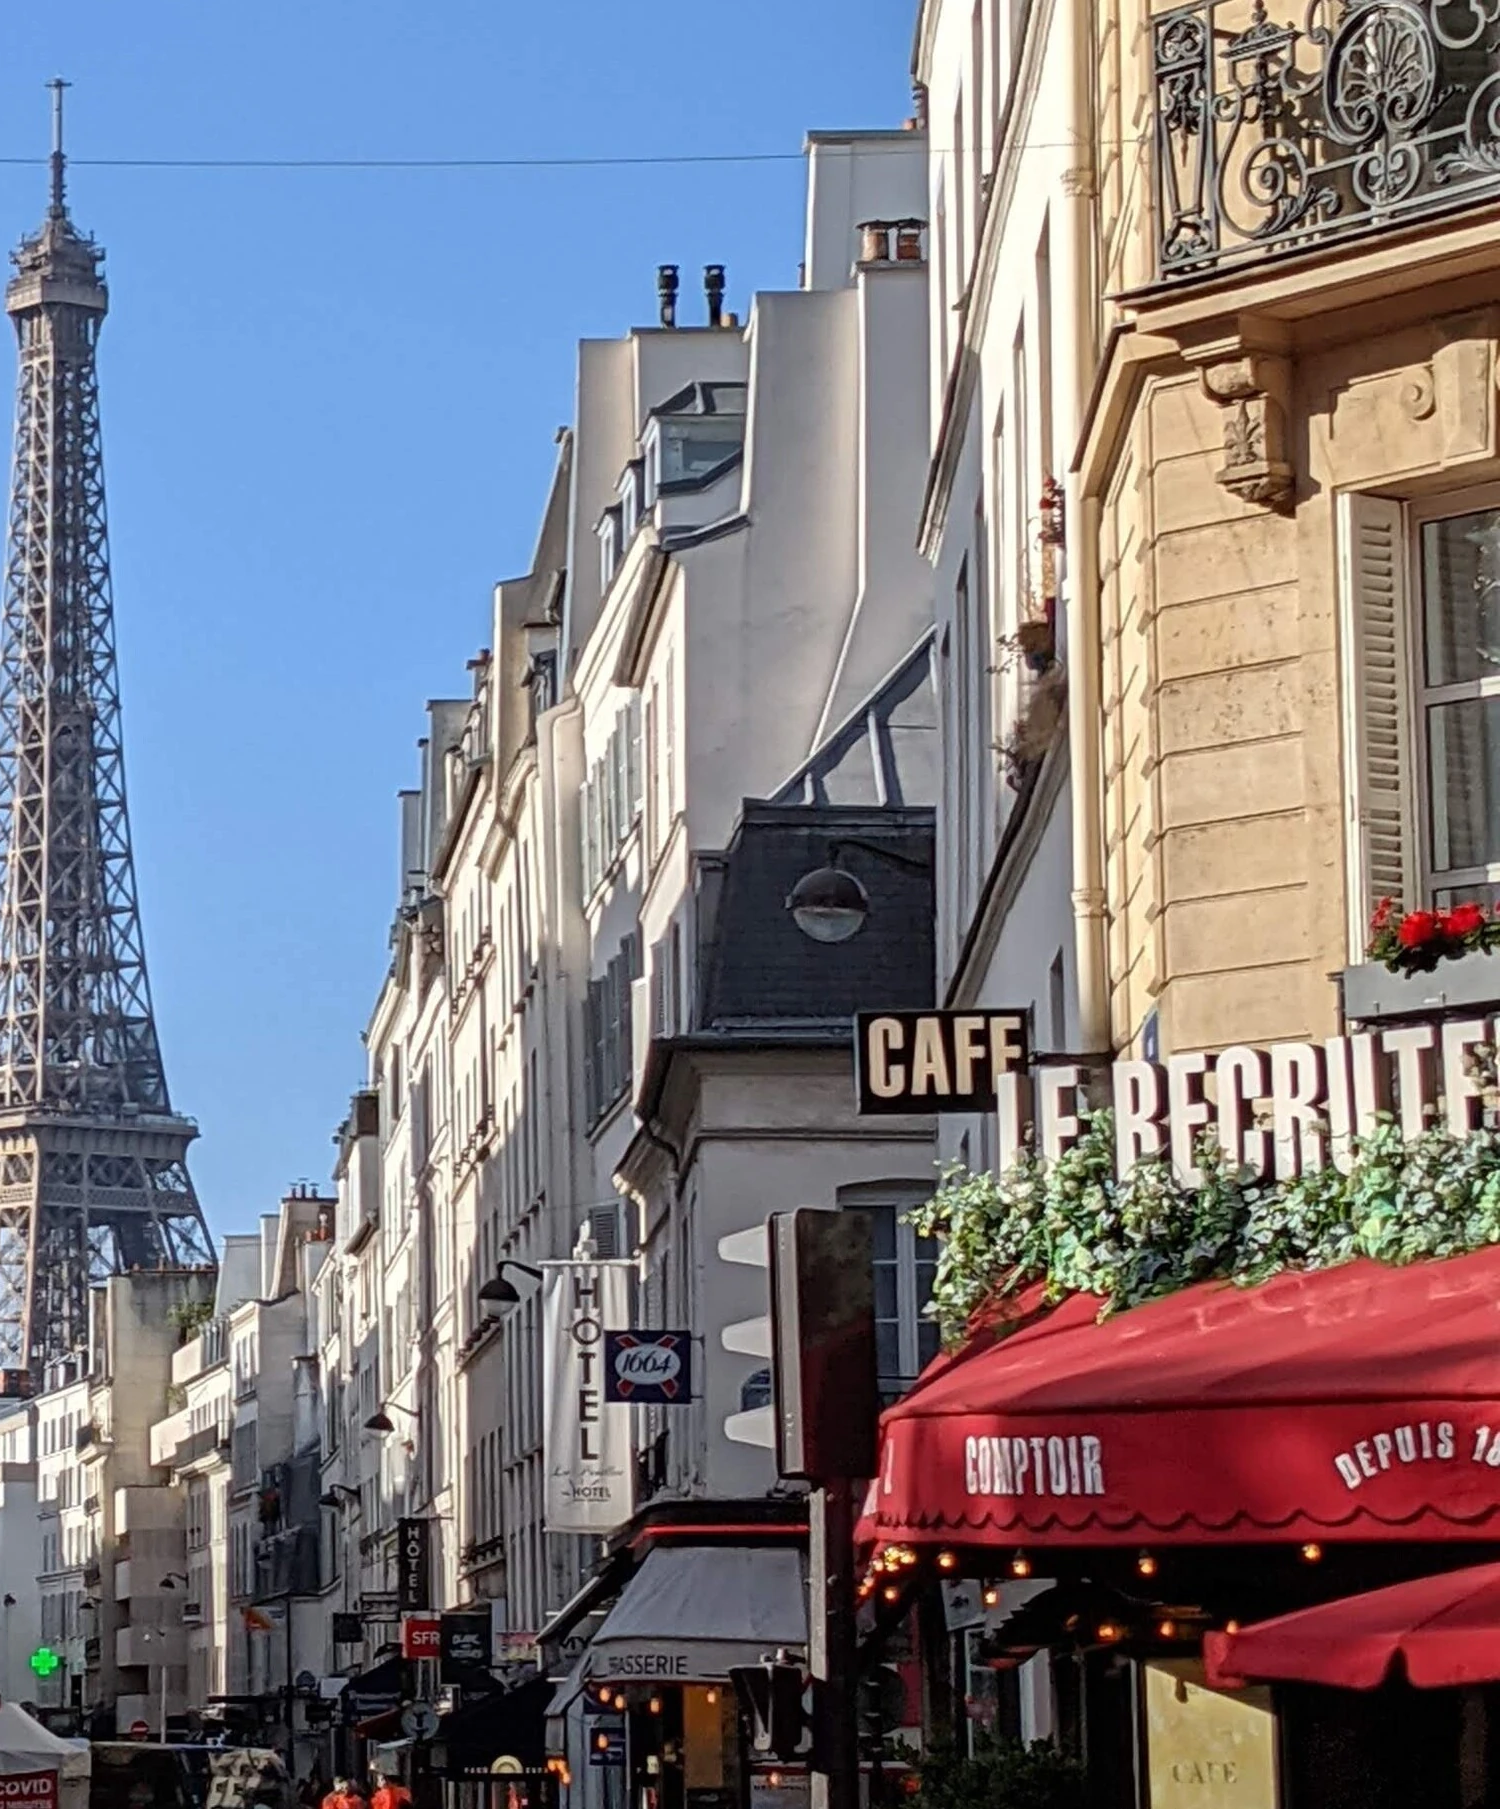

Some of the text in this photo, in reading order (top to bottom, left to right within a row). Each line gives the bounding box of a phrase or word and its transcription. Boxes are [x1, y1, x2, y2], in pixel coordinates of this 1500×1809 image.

[866, 1015, 1023, 1098] CAFE
[998, 1019, 1500, 1186] LE RECRUTE
[572, 1276, 601, 1461] HOTEL
[621, 1352, 672, 1375] 1664
[964, 1434, 1105, 1495] COMPTOIR
[1334, 1421, 1455, 1490] DEPUIS
[411, 1630, 440, 1646] SFR
